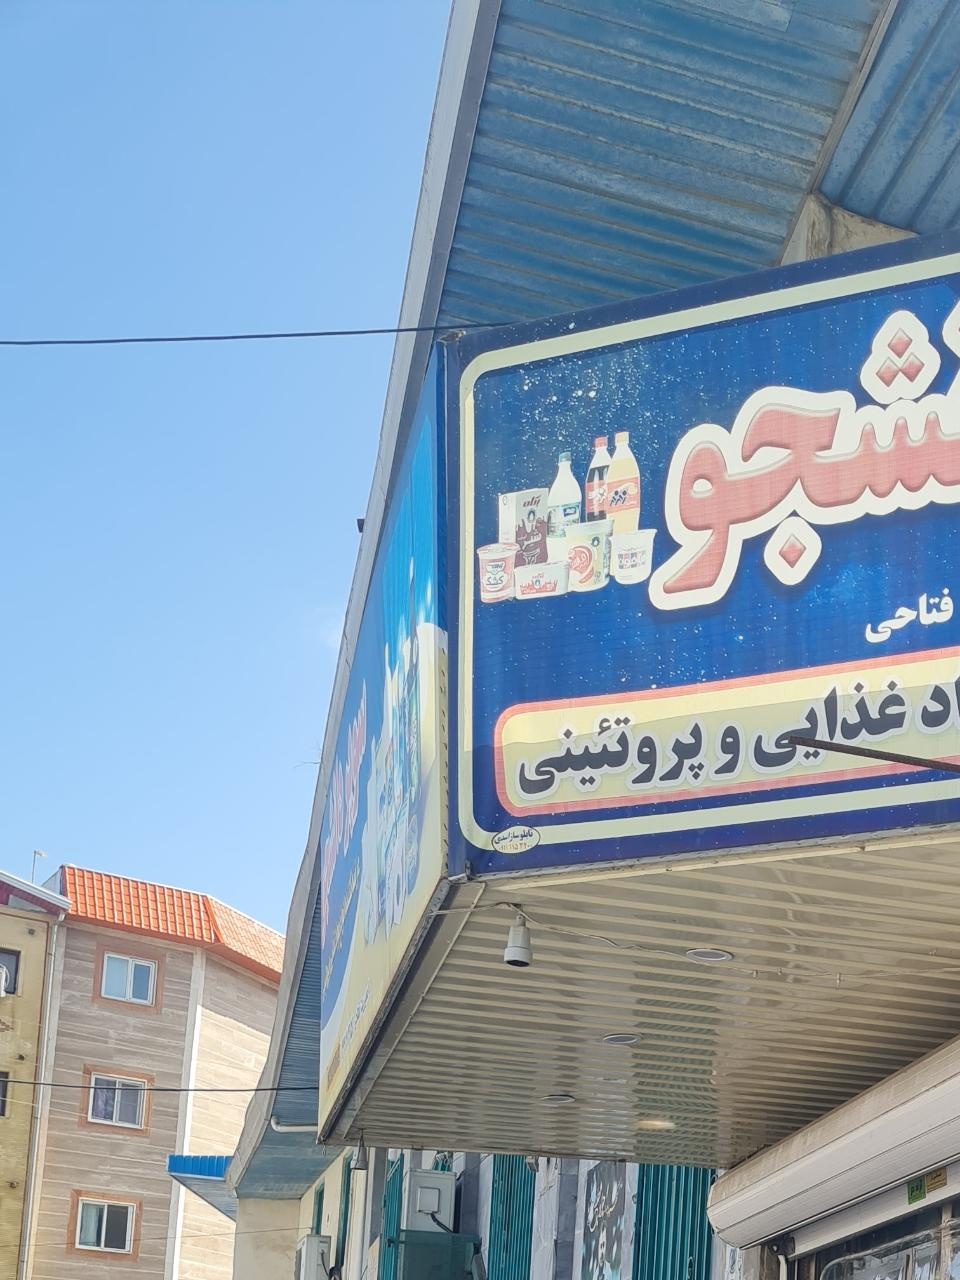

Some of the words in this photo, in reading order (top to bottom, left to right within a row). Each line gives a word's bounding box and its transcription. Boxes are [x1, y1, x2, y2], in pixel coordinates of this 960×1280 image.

[865, 587, 954, 643] فتاحی
[519, 716, 703, 791] پروتئینی
[714, 724, 741, 775] و
[753, 679, 907, 767] غذایی
